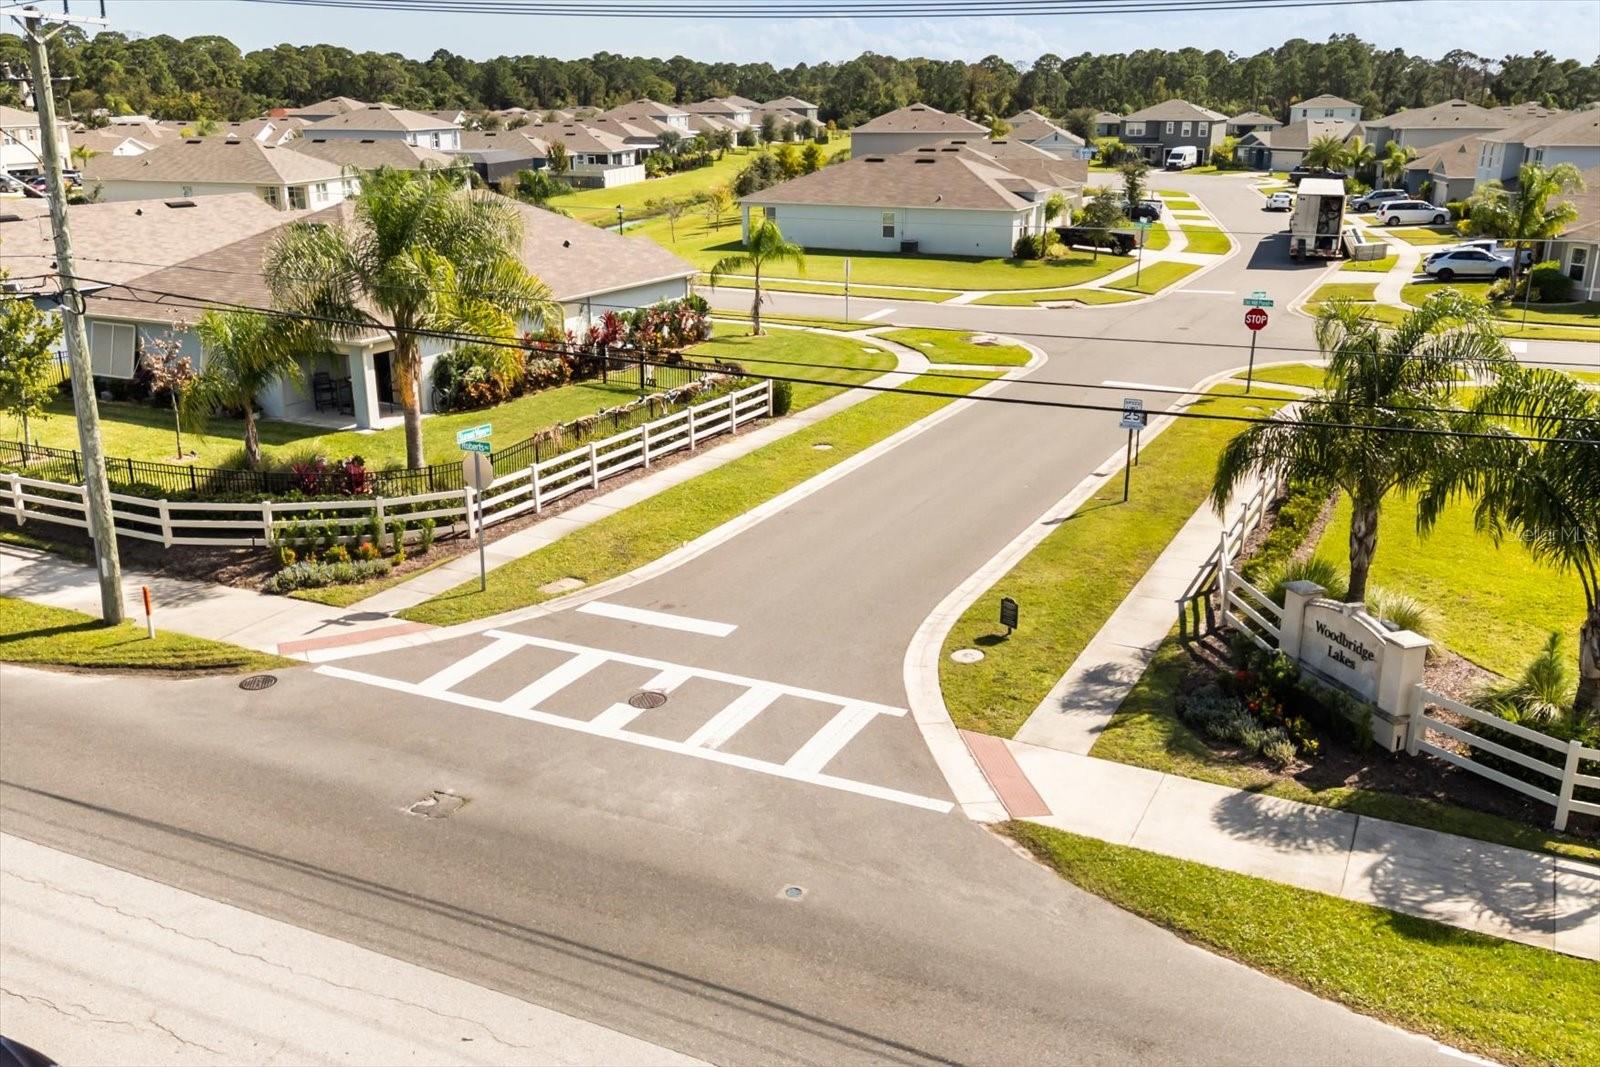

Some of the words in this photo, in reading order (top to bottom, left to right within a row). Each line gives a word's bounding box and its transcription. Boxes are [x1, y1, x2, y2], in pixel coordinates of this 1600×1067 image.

[1246, 315, 1267, 324] STOP
[1124, 409, 1140, 421] 25
[462, 441, 484, 451] Roberts
[1315, 620, 1375, 662] Woodbridge
[1327, 645, 1356, 670] Lakes
